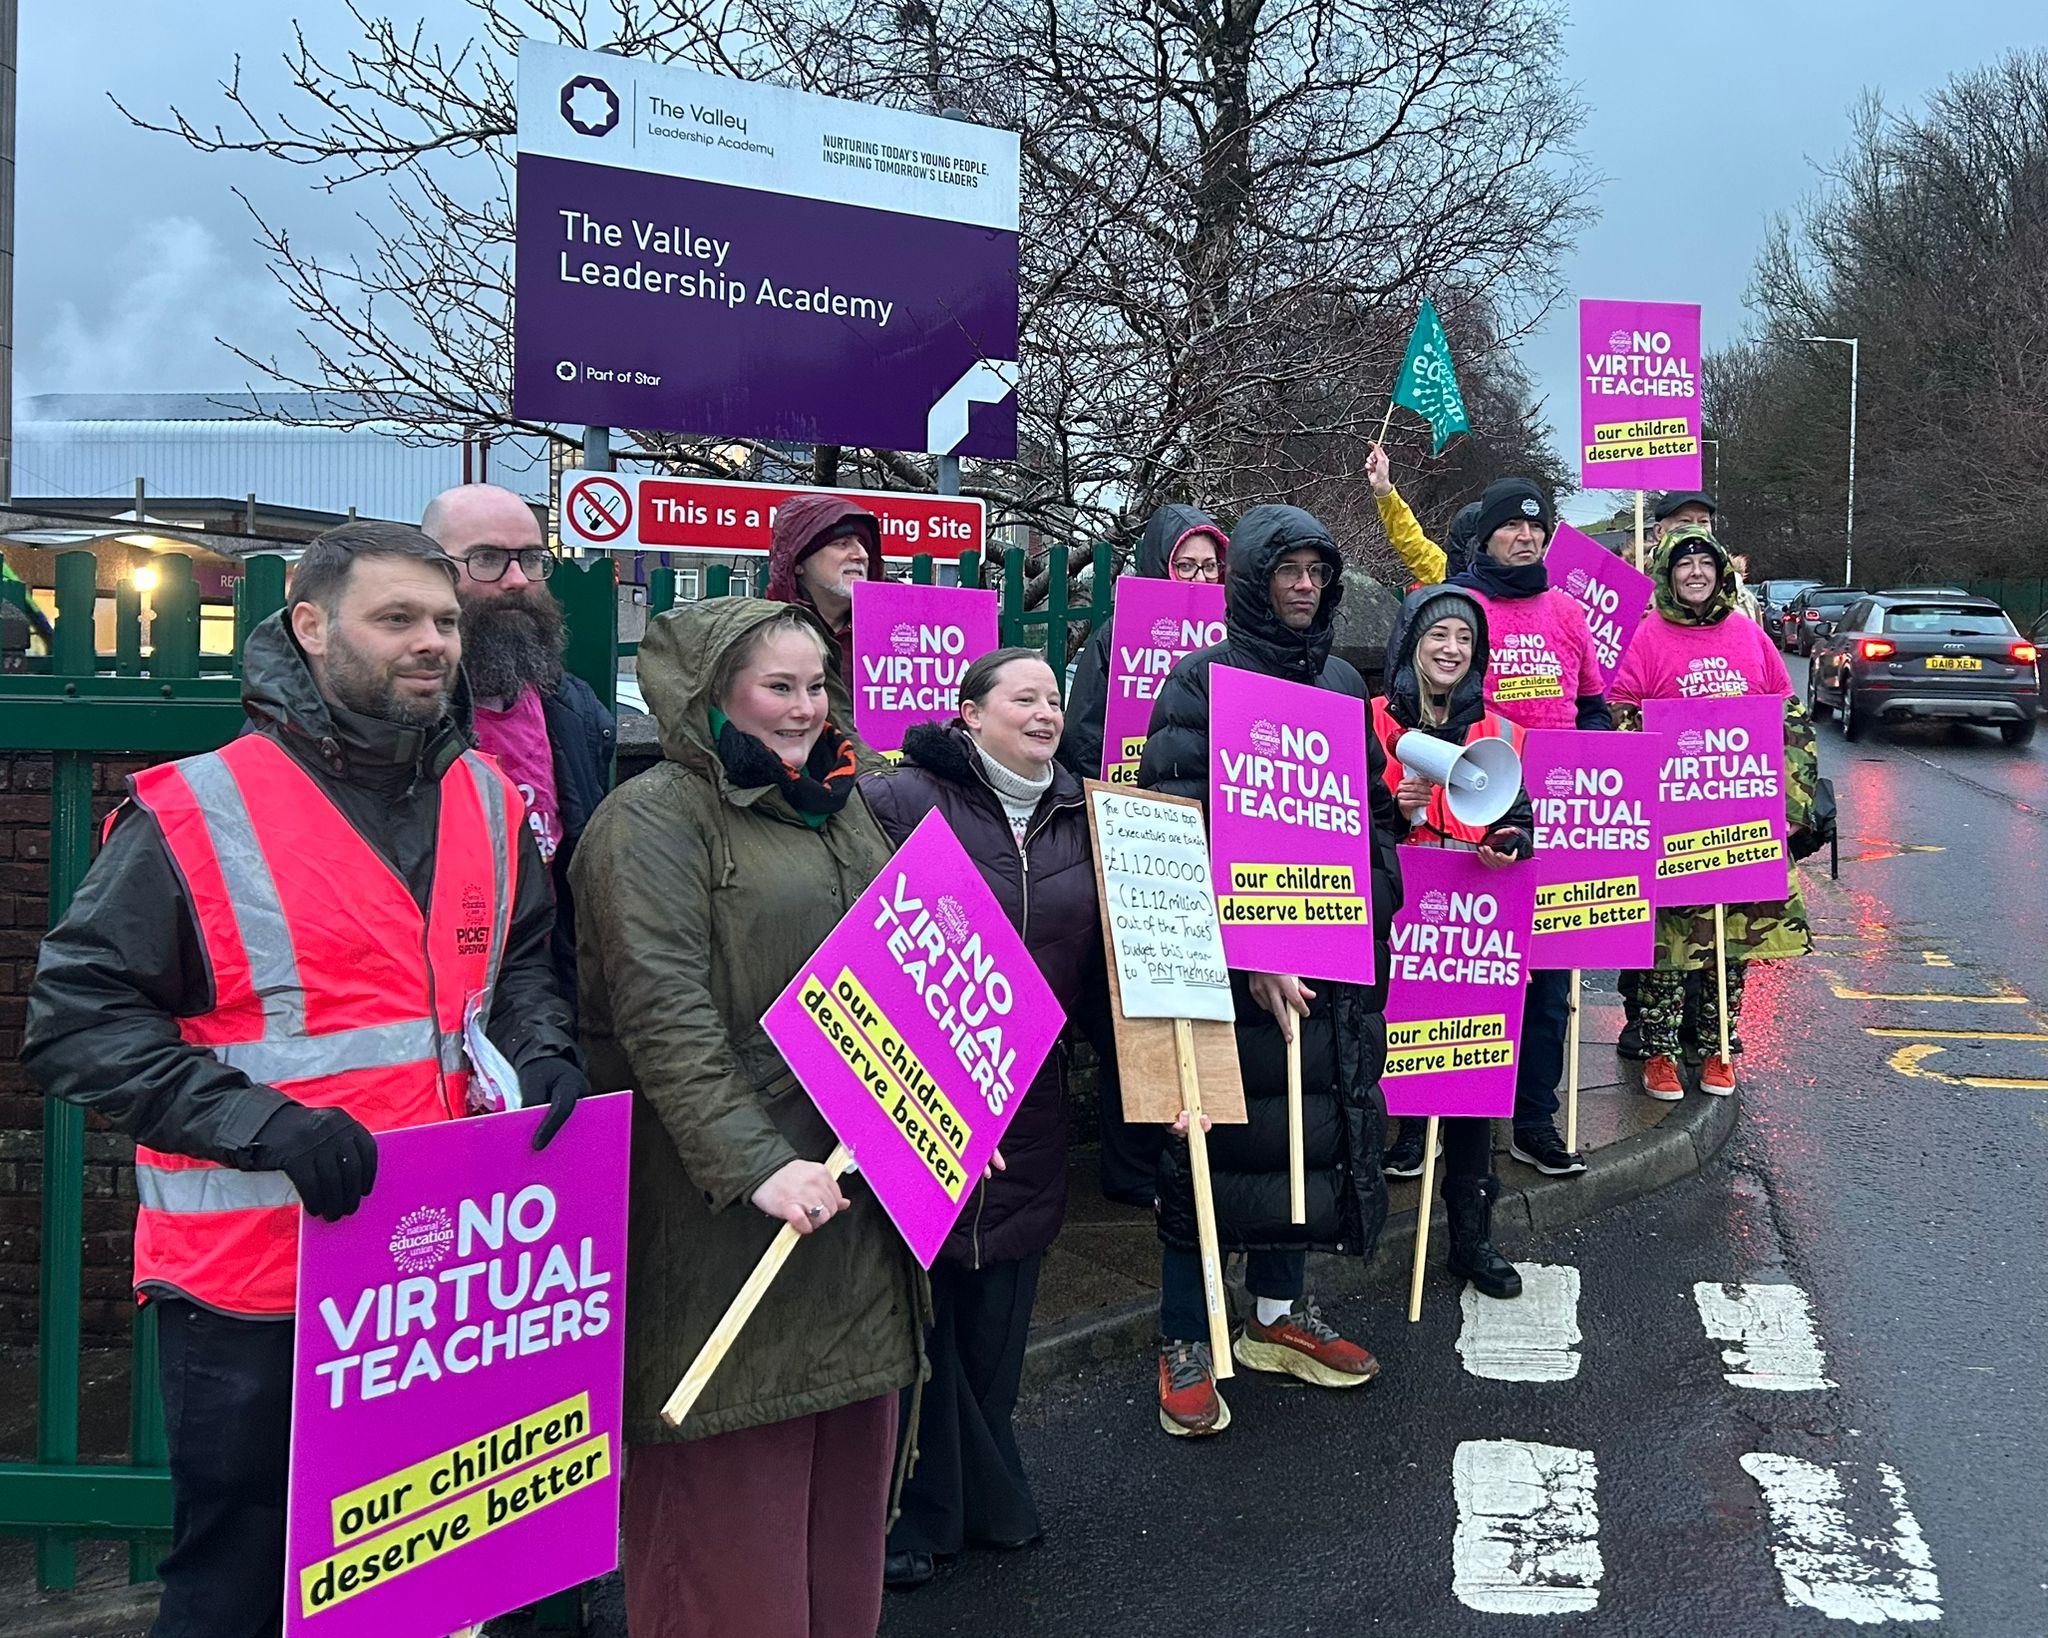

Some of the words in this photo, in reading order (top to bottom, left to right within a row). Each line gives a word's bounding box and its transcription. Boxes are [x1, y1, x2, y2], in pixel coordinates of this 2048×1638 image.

[649, 96, 684, 119] The
[690, 104, 747, 135] Valley
[648, 123, 714, 146] Leadership
[717, 135, 774, 158] Academy
[823, 134, 878, 156] NURTURING
[881, 144, 918, 163] TODAY'S
[920, 151, 950, 169] YOUNG
[823, 150, 872, 170] INSPIRING
[875, 159, 935, 181] TOMORROW'S
[938, 170, 978, 188] LEADERS
[559, 209, 622, 247] The
[632, 220, 730, 267] Valley
[560, 251, 746, 309] Leadership
[755, 278, 894, 327] Academy
[1633, 330, 1671, 355] NO
[587, 367, 614, 381] Part
[617, 371, 632, 383] of
[634, 372, 661, 386] Star
[1586, 353, 1694, 379] VIRTUAL
[1586, 376, 1695, 398] TEACHERS
[1597, 428, 1622, 440] our
[1627, 421, 1686, 437] children
[1588, 447, 1644, 461] deserve
[1649, 441, 1694, 456] better
[651, 498, 707, 525] This
[716, 505, 735, 527] is
[744, 509, 760, 528] a
[928, 516, 972, 539] Site
[1583, 577, 1619, 614] NO
[920, 624, 964, 655] NO
[1180, 619, 1228, 648] NO
[1520, 634, 1545, 649] NO
[1490, 648, 1561, 664] VIRTUAL
[1490, 662, 1563, 676] TEACHERS
[1702, 657, 1728, 669] NO
[1955, 660, 1976, 668] XEN
[862, 655, 971, 685] VIRTUA
[1500, 680, 1517, 688] our
[1520, 677, 1556, 686] children
[1676, 670, 1746, 687] VIRTUAL
[862, 686, 960, 711] TEACHE
[1495, 691, 1532, 700] deserve
[1535, 688, 1560, 697] better
[1679, 681, 1749, 698] TEACHERS
[1281, 723, 1329, 765] NO
[1705, 727, 1749, 753] NO
[1220, 748, 1360, 808] VIRTUAL
[1659, 753, 1777, 780] VIRTUAL
[1574, 768, 1623, 796] NO
[1659, 777, 1778, 802] TEACHERS
[1102, 798, 1119, 817] The
[1124, 801, 1151, 817] CEO
[1182, 812, 1197, 828] top
[1220, 783, 1361, 836] TEACHERS
[1106, 820, 1114, 836] 5
[1169, 836, 1181, 846] are
[1533, 826, 1650, 850] EACHERS
[1667, 838, 1695, 853] our
[1702, 826, 1769, 847] children
[1657, 857, 1720, 876] deserve
[1726, 845, 1778, 865] better
[1235, 871, 1268, 889] our
[1276, 866, 1352, 890] children
[1536, 891, 1556, 906] ur
[1563, 881, 1636, 903] children
[1223, 898, 1298, 921] deserve
[1304, 898, 1363, 921] better
[1449, 891, 1498, 925] NO
[1533, 914, 1582, 932] serve
[1589, 906, 1646, 925] better
[456, 926, 490, 943] PICKET
[1142, 916, 1155, 936] of
[1158, 917, 1178, 935] the
[1122, 940, 1156, 963] budget
[1161, 940, 1183, 959] this
[1186, 950, 1211, 966] year
[1390, 921, 1521, 961] VIRTUAL
[893, 871, 1016, 1095] VIRTUAL
[959, 932, 1014, 1016] NO
[1125, 963, 1138, 980] to
[1148, 962, 1173, 978] PAY
[1390, 954, 1519, 986] TEACHERS
[873, 895, 1014, 1117] TEACHERS
[1388, 1029, 1421, 1045] our
[1428, 1018, 1502, 1042] children
[838, 980, 877, 1029] our
[881, 1037, 964, 1151] children
[1385, 1052, 1445, 1073] eserve
[1452, 1047, 1509, 1068] better
[804, 989, 887, 1100] deserve
[892, 1095, 960, 1188] better
[407, 1220, 438, 1235] national
[458, 1184, 556, 1258] NO
[389, 1229, 454, 1252] education
[410, 1245, 433, 1256] union
[318, 1237, 611, 1351] VIRTUAL
[315, 1290, 610, 1409] TEACHERS
[339, 1481, 412, 1535] our
[429, 1407, 584, 1496] children
[309, 1511, 471, 1607] deserve
[486, 1448, 602, 1526] better
